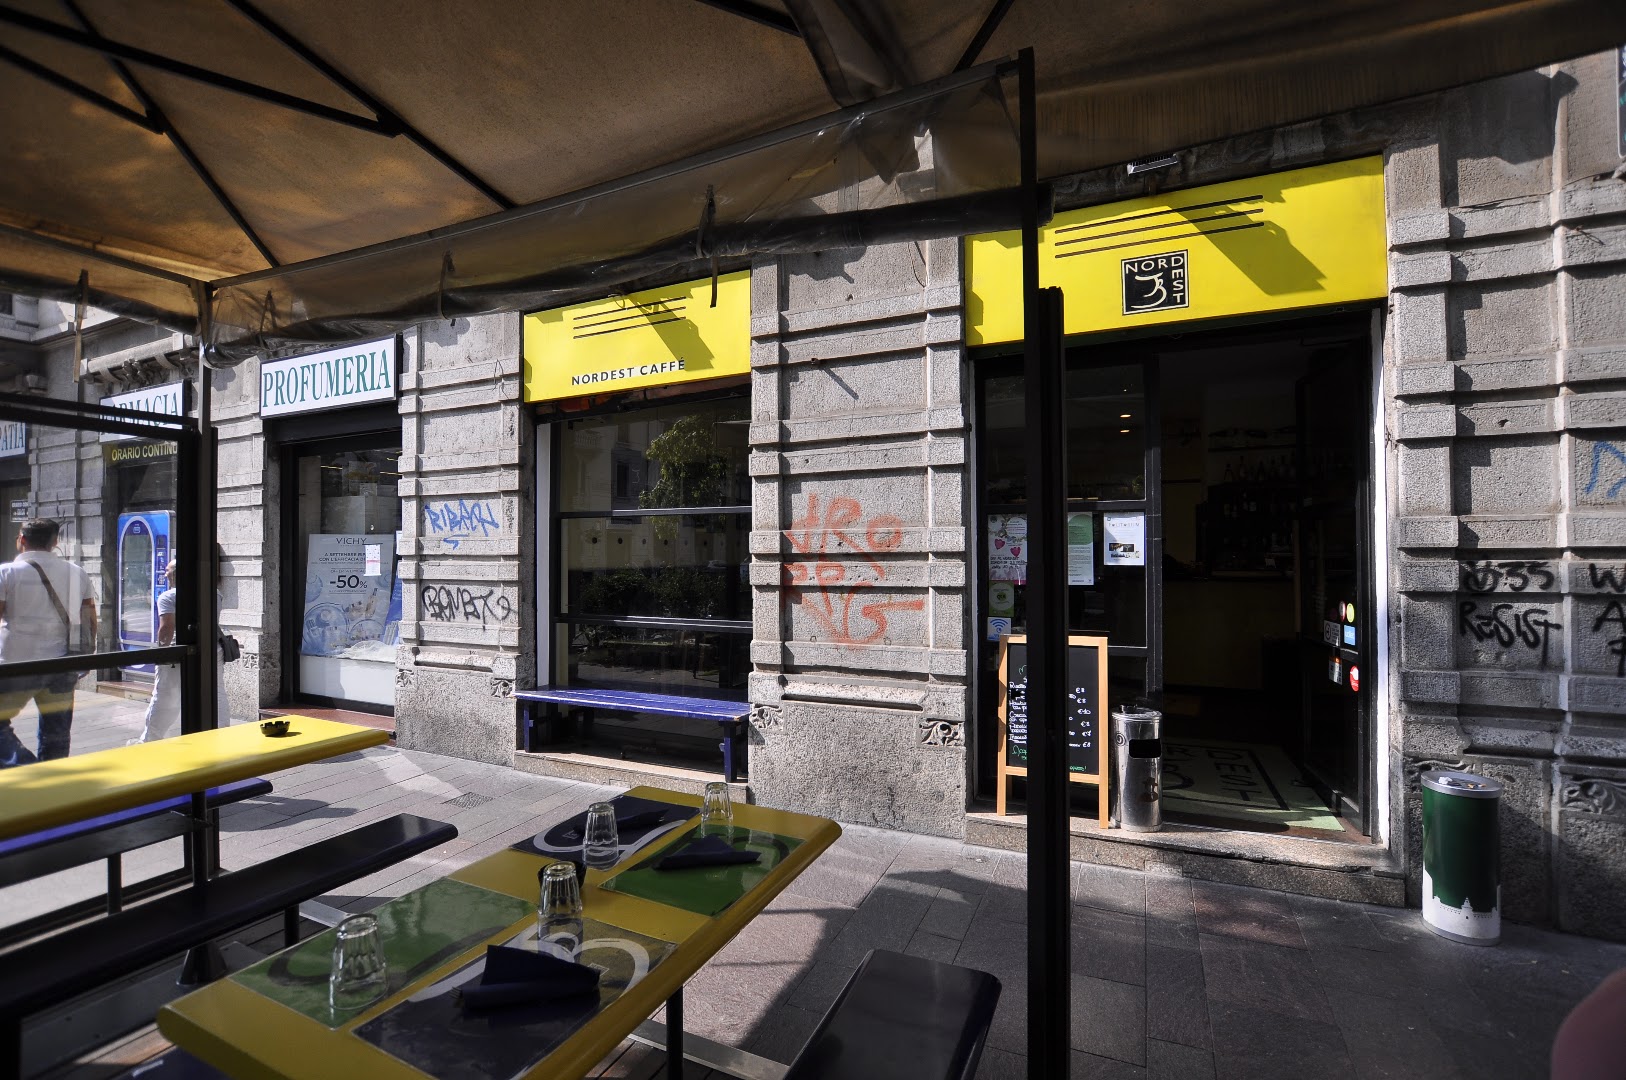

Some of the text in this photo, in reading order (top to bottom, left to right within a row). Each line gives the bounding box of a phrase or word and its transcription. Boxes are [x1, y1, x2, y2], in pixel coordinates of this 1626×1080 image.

[262, 348, 391, 408] PROFUMERIA
[571, 356, 685, 386] NORDEST CAFFÉ
[0, 421, 24, 451] ATIA
[111, 442, 178, 462] ORARIO CONTINU
[335, 537, 367, 545] VICHY
[329, 574, 368, 589] -50%
